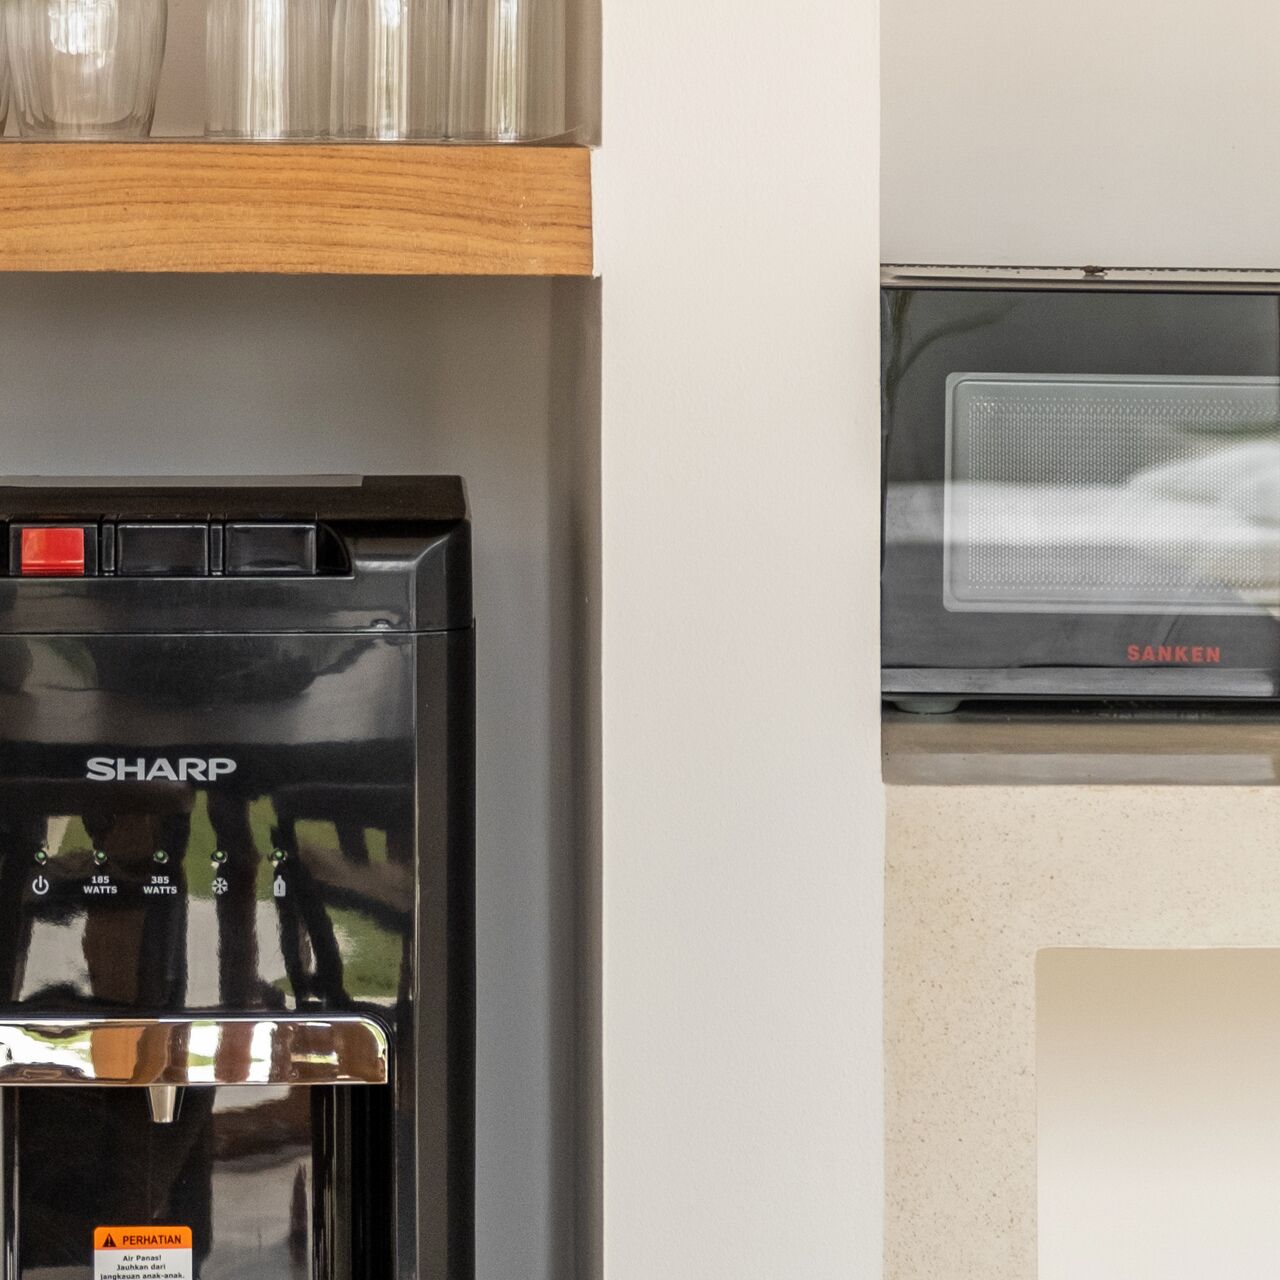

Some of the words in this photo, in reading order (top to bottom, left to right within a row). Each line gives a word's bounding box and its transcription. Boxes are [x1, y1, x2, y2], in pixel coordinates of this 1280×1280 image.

[1127, 644, 1220, 662] SANKEN
[86, 757, 237, 781] SHARP
[91, 876, 110, 884] 185
[151, 876, 169, 884] 385
[83, 886, 118, 894] WATTS
[143, 886, 177, 894] WATTS
[122, 1235, 182, 1245] PERHATIAN
